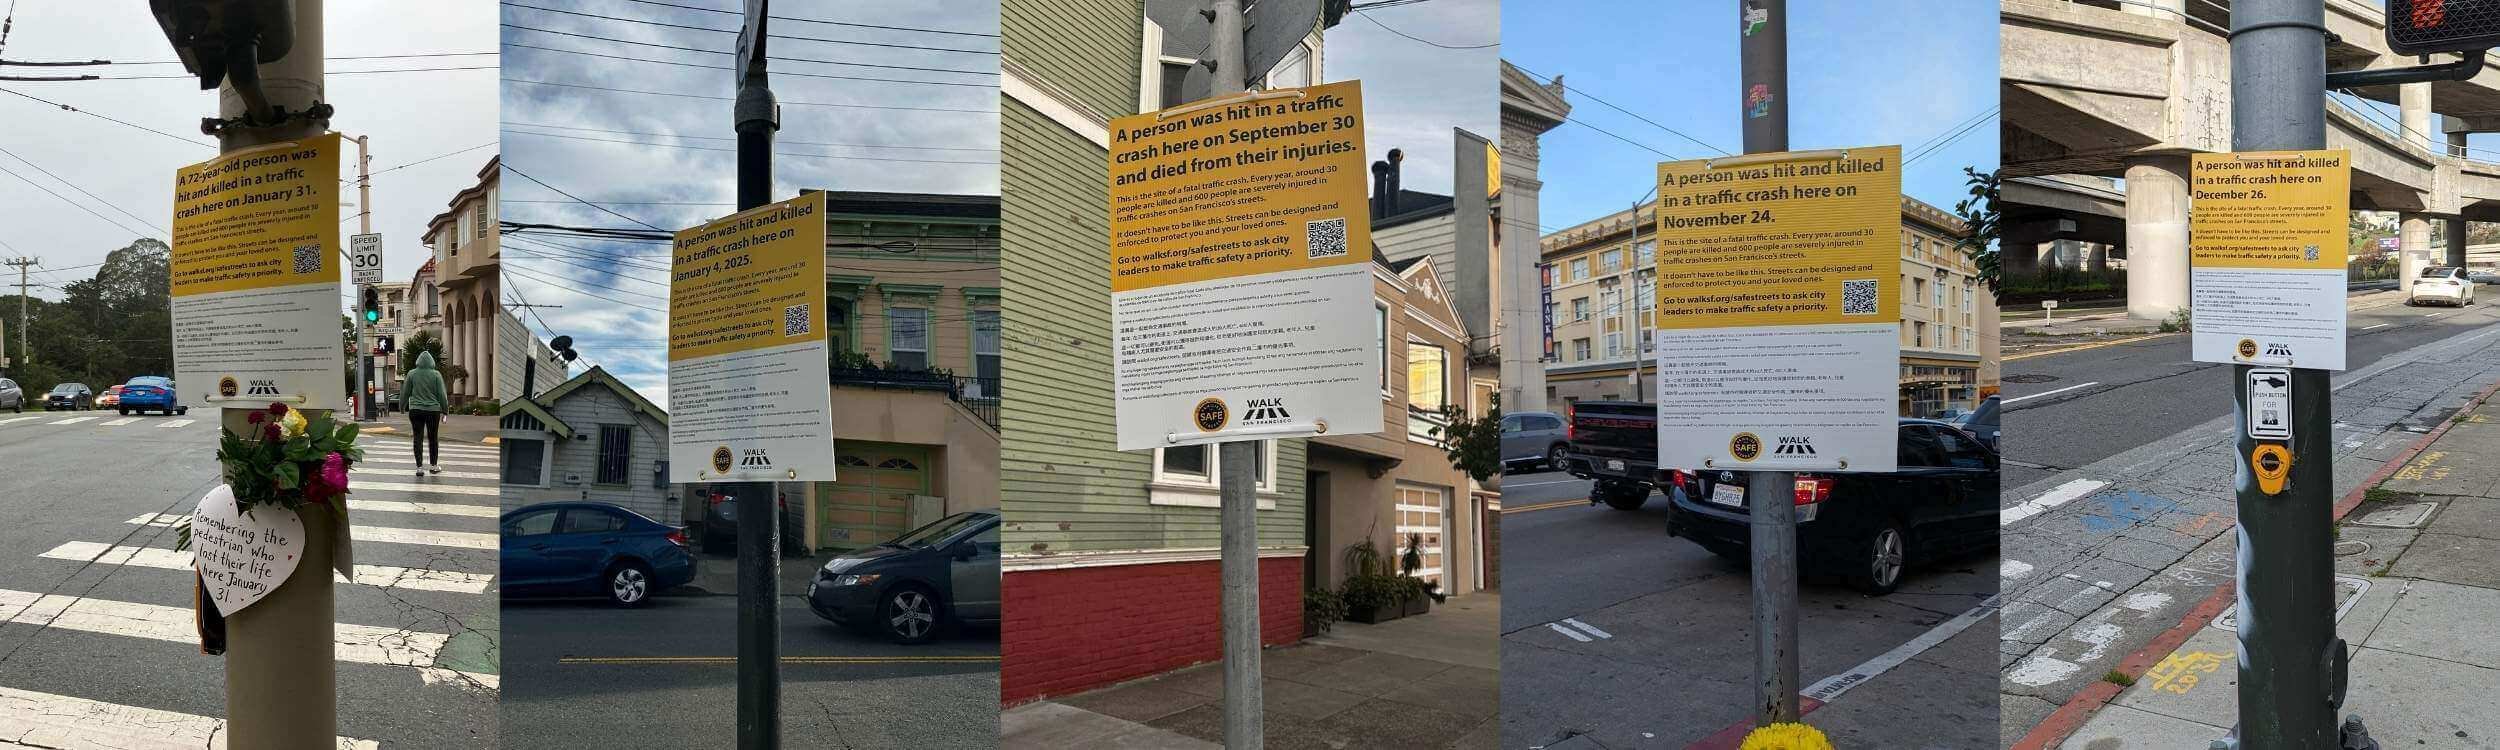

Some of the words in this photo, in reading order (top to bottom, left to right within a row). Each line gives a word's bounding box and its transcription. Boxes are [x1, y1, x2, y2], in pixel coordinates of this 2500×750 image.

[1116, 127, 1127, 142] A
[1131, 119, 1186, 142] person
[1190, 112, 1222, 128] was
[1227, 105, 1251, 121] hit
[1255, 102, 1271, 117] in
[1276, 103, 1285, 114] a
[1290, 94, 1343, 112] traffic
[1116, 142, 1158, 163] crash
[1162, 139, 1199, 155] here
[1202, 134, 1224, 148] on
[1228, 119, 1327, 144] September
[1332, 114, 1355, 130] 30
[178, 175, 186, 186] A
[188, 160, 240, 184] 72-year-old
[242, 154, 287, 172] person
[291, 150, 316, 161] was
[1116, 166, 1146, 185] and
[1150, 160, 1186, 180] died
[1190, 157, 1231, 174] from
[1235, 148, 1278, 166] their
[1283, 140, 1356, 161] injuries.
[1663, 172, 1674, 186] A
[1679, 172, 1733, 188] person
[1737, 169, 1769, 181] was
[1773, 164, 1796, 178] hit
[1799, 161, 1831, 177] and
[1836, 158, 1883, 174] killed
[2196, 161, 2203, 170] A
[2206, 162, 2241, 172] person
[2267, 159, 2282, 169] hit
[2284, 158, 2305, 168] and
[2308, 158, 2339, 168] killed
[177, 191, 190, 202] hit
[191, 186, 209, 199] and
[211, 178, 238, 195] killed
[240, 177, 251, 187] in
[255, 176, 262, 184] a
[265, 168, 304, 182] traffic
[1117, 194, 1131, 203] This
[1139, 191, 1152, 200] the
[1153, 190, 1167, 198] site
[1183, 184, 1200, 194] fatal
[1202, 181, 1224, 191] traffic
[1225, 177, 1249, 188] crash.
[1250, 176, 1273, 184] Every
[1274, 173, 1293, 183] year,
[1295, 166, 1325, 178] around
[2196, 176, 2205, 185] in
[2216, 175, 2246, 185] traffic
[2248, 174, 2277, 184] crash
[2280, 174, 2304, 184] here
[176, 204, 200, 219] crash
[202, 202, 223, 213] here
[225, 198, 239, 208] on
[241, 190, 292, 205] January
[296, 184, 316, 197] 31.
[1664, 194, 1678, 207] in
[1682, 196, 1691, 206] a
[1694, 190, 1742, 205] traffic
[1746, 186, 1788, 202] crash
[1793, 186, 1831, 200] here
[1835, 186, 1856, 197] on
[2196, 189, 2248, 199] December
[2250, 190, 2266, 199] 26.
[1116, 212, 1137, 222] traffic
[1139, 208, 1166, 219] crashes
[1179, 205, 1193, 213] San
[1194, 198, 1236, 211] Francisco's
[1237, 195, 1266, 205] streets.
[1664, 211, 1747, 228] November
[1750, 210, 1775, 224] 24.
[676, 238, 683, 249] A
[685, 231, 716, 249] person
[718, 226, 737, 238] was
[739, 219, 754, 232] hit
[756, 212, 777, 228] and
[780, 202, 812, 220] killed
[675, 255, 684, 265] in
[686, 254, 691, 263] a
[693, 246, 720, 261] traffic
[722, 236, 749, 254] crash
[752, 233, 777, 246] here
[779, 228, 794, 240] on
[1142, 242, 1240, 261] walksf.org/safestreets
[1254, 237, 1270, 248] ask
[1271, 236, 1289, 246] city
[355, 254, 378, 268] 30
[674, 266, 711, 282] January
[713, 261, 722, 273] 4,
[724, 254, 752, 270] 2025.
[1118, 265, 1149, 276] leaders
[1162, 260, 1186, 270] make
[1188, 257, 1214, 268] traffic
[1216, 254, 1244, 264] safety
[1254, 249, 1292, 262] priority.
[1663, 307, 1693, 315] leaders
[1705, 306, 1728, 314] make
[1730, 305, 1755, 313] traffic
[1757, 304, 1783, 313] safety
[1792, 303, 1828, 313] priority.
[1687, 293, 1780, 304] walksf.org/safestreets
[1792, 291, 1808, 300] ask
[1809, 291, 1826, 300] city
[1201, 412, 1223, 421] SAFE
[1247, 398, 1282, 408] WALK
[195, 508, 255, 544] Remembering
[264, 528, 288, 546] the
[193, 529, 243, 554] pedestrian
[252, 546, 274, 561] who
[200, 543, 217, 562] lost
[221, 552, 246, 569] their
[250, 560, 272, 579] life
[203, 564, 223, 581] here
[226, 572, 267, 597] January
[216, 588, 232, 603] 31.
